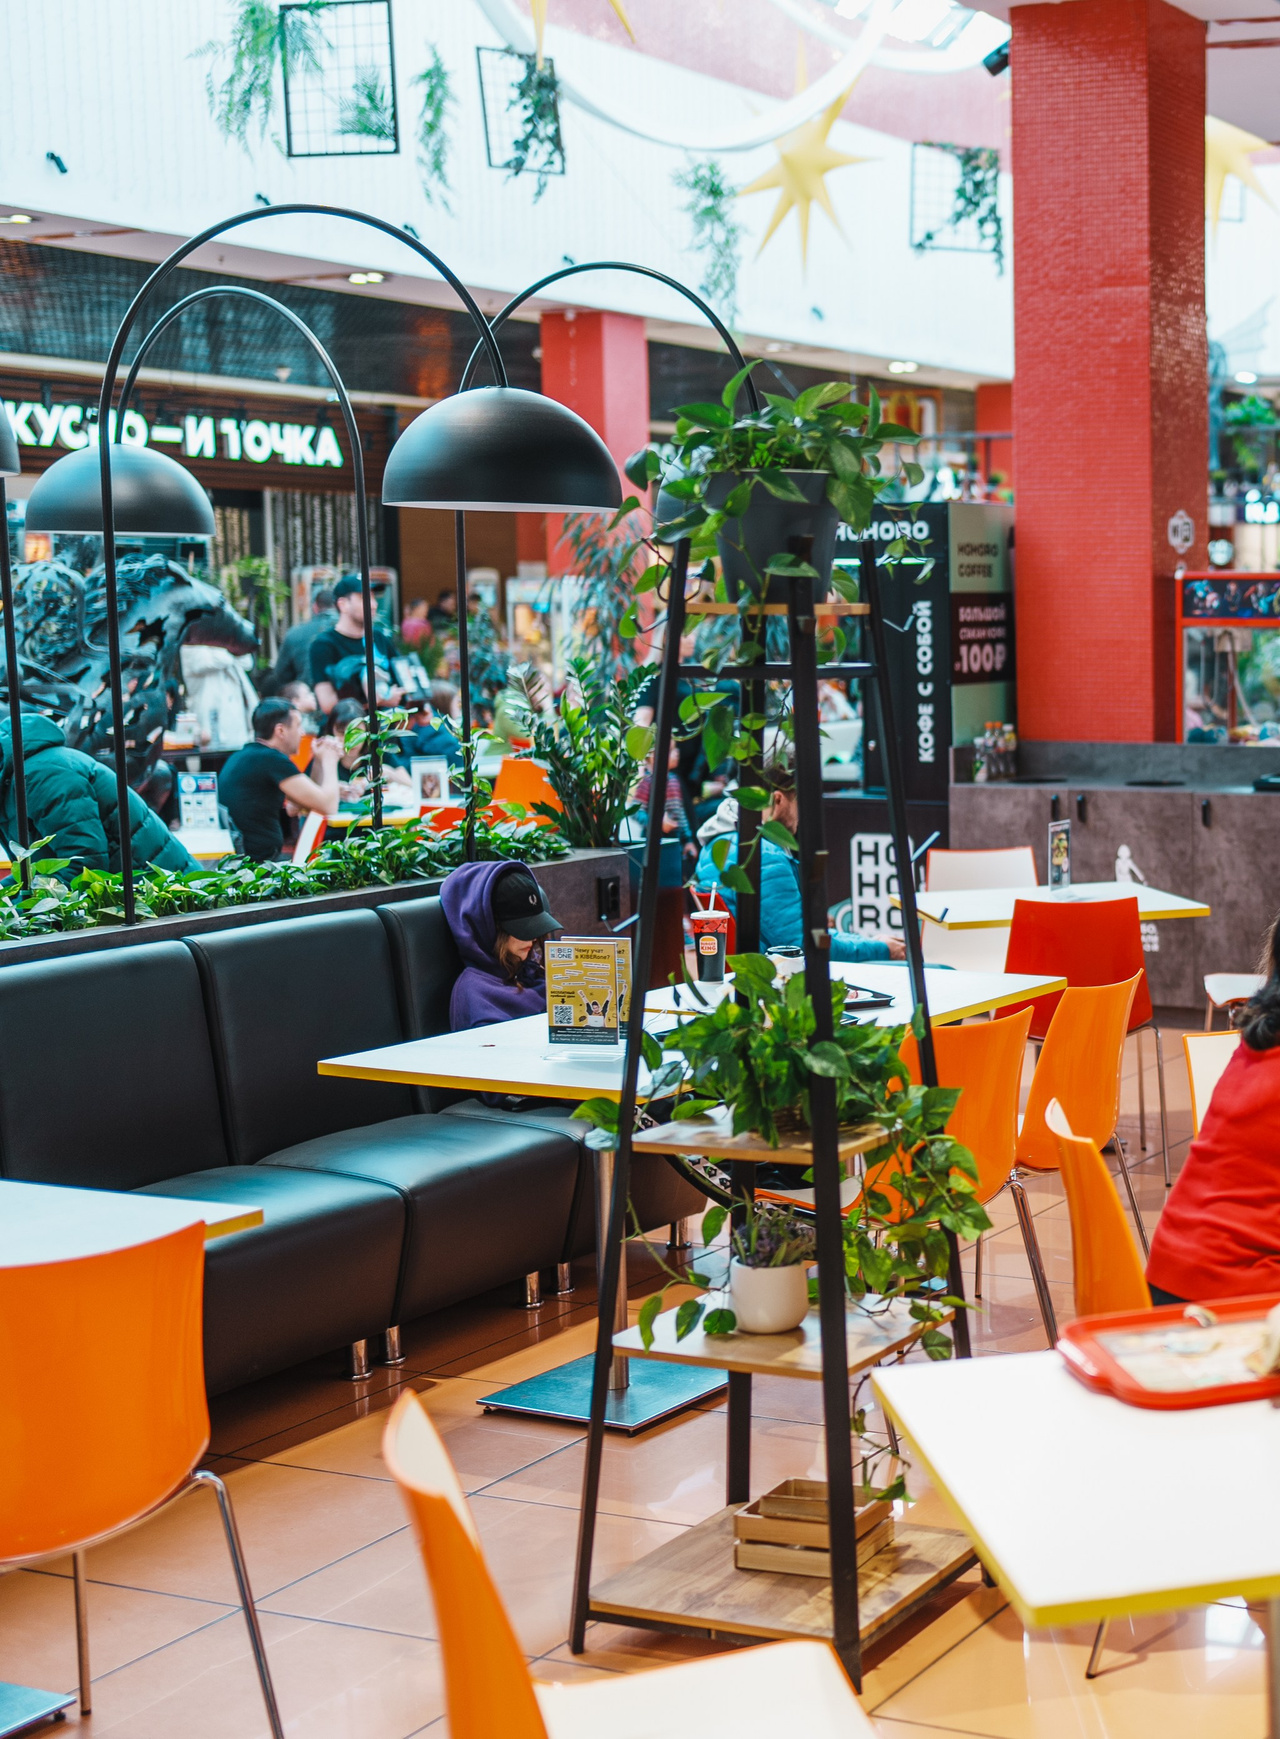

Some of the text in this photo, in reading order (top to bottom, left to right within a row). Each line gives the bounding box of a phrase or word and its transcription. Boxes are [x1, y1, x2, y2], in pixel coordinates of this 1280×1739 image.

[957, 564, 994, 578] COFFEE
[912, 600, 934, 676] СОБОЙ
[918, 703, 935, 763] КОФЕ
